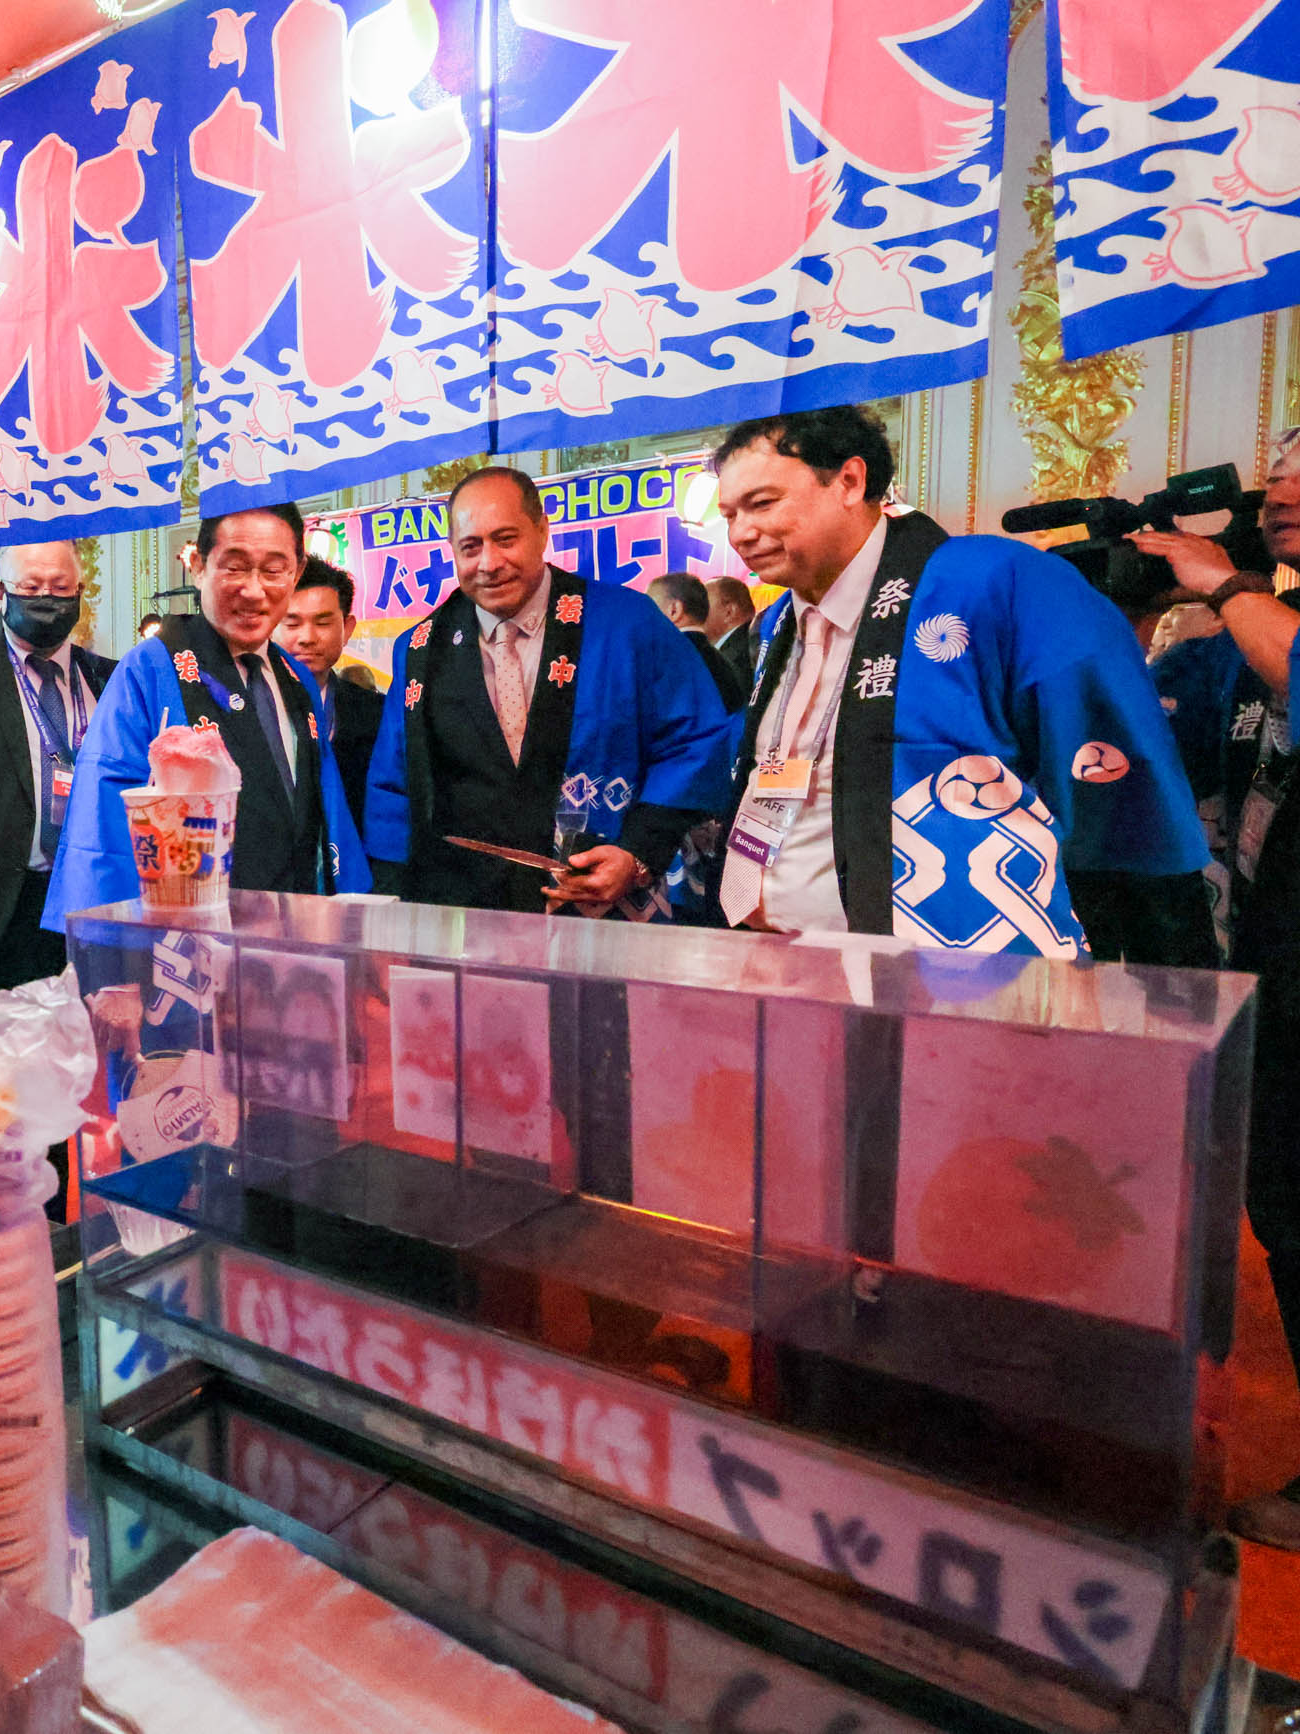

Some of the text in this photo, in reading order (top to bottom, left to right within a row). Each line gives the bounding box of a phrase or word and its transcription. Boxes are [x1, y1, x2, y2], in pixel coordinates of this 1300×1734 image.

[188, 0, 480, 388] 氷
[371, 505, 450, 547] BAN
[135, 834, 160, 871] 祭
[734, 834, 766, 857] Banquet
